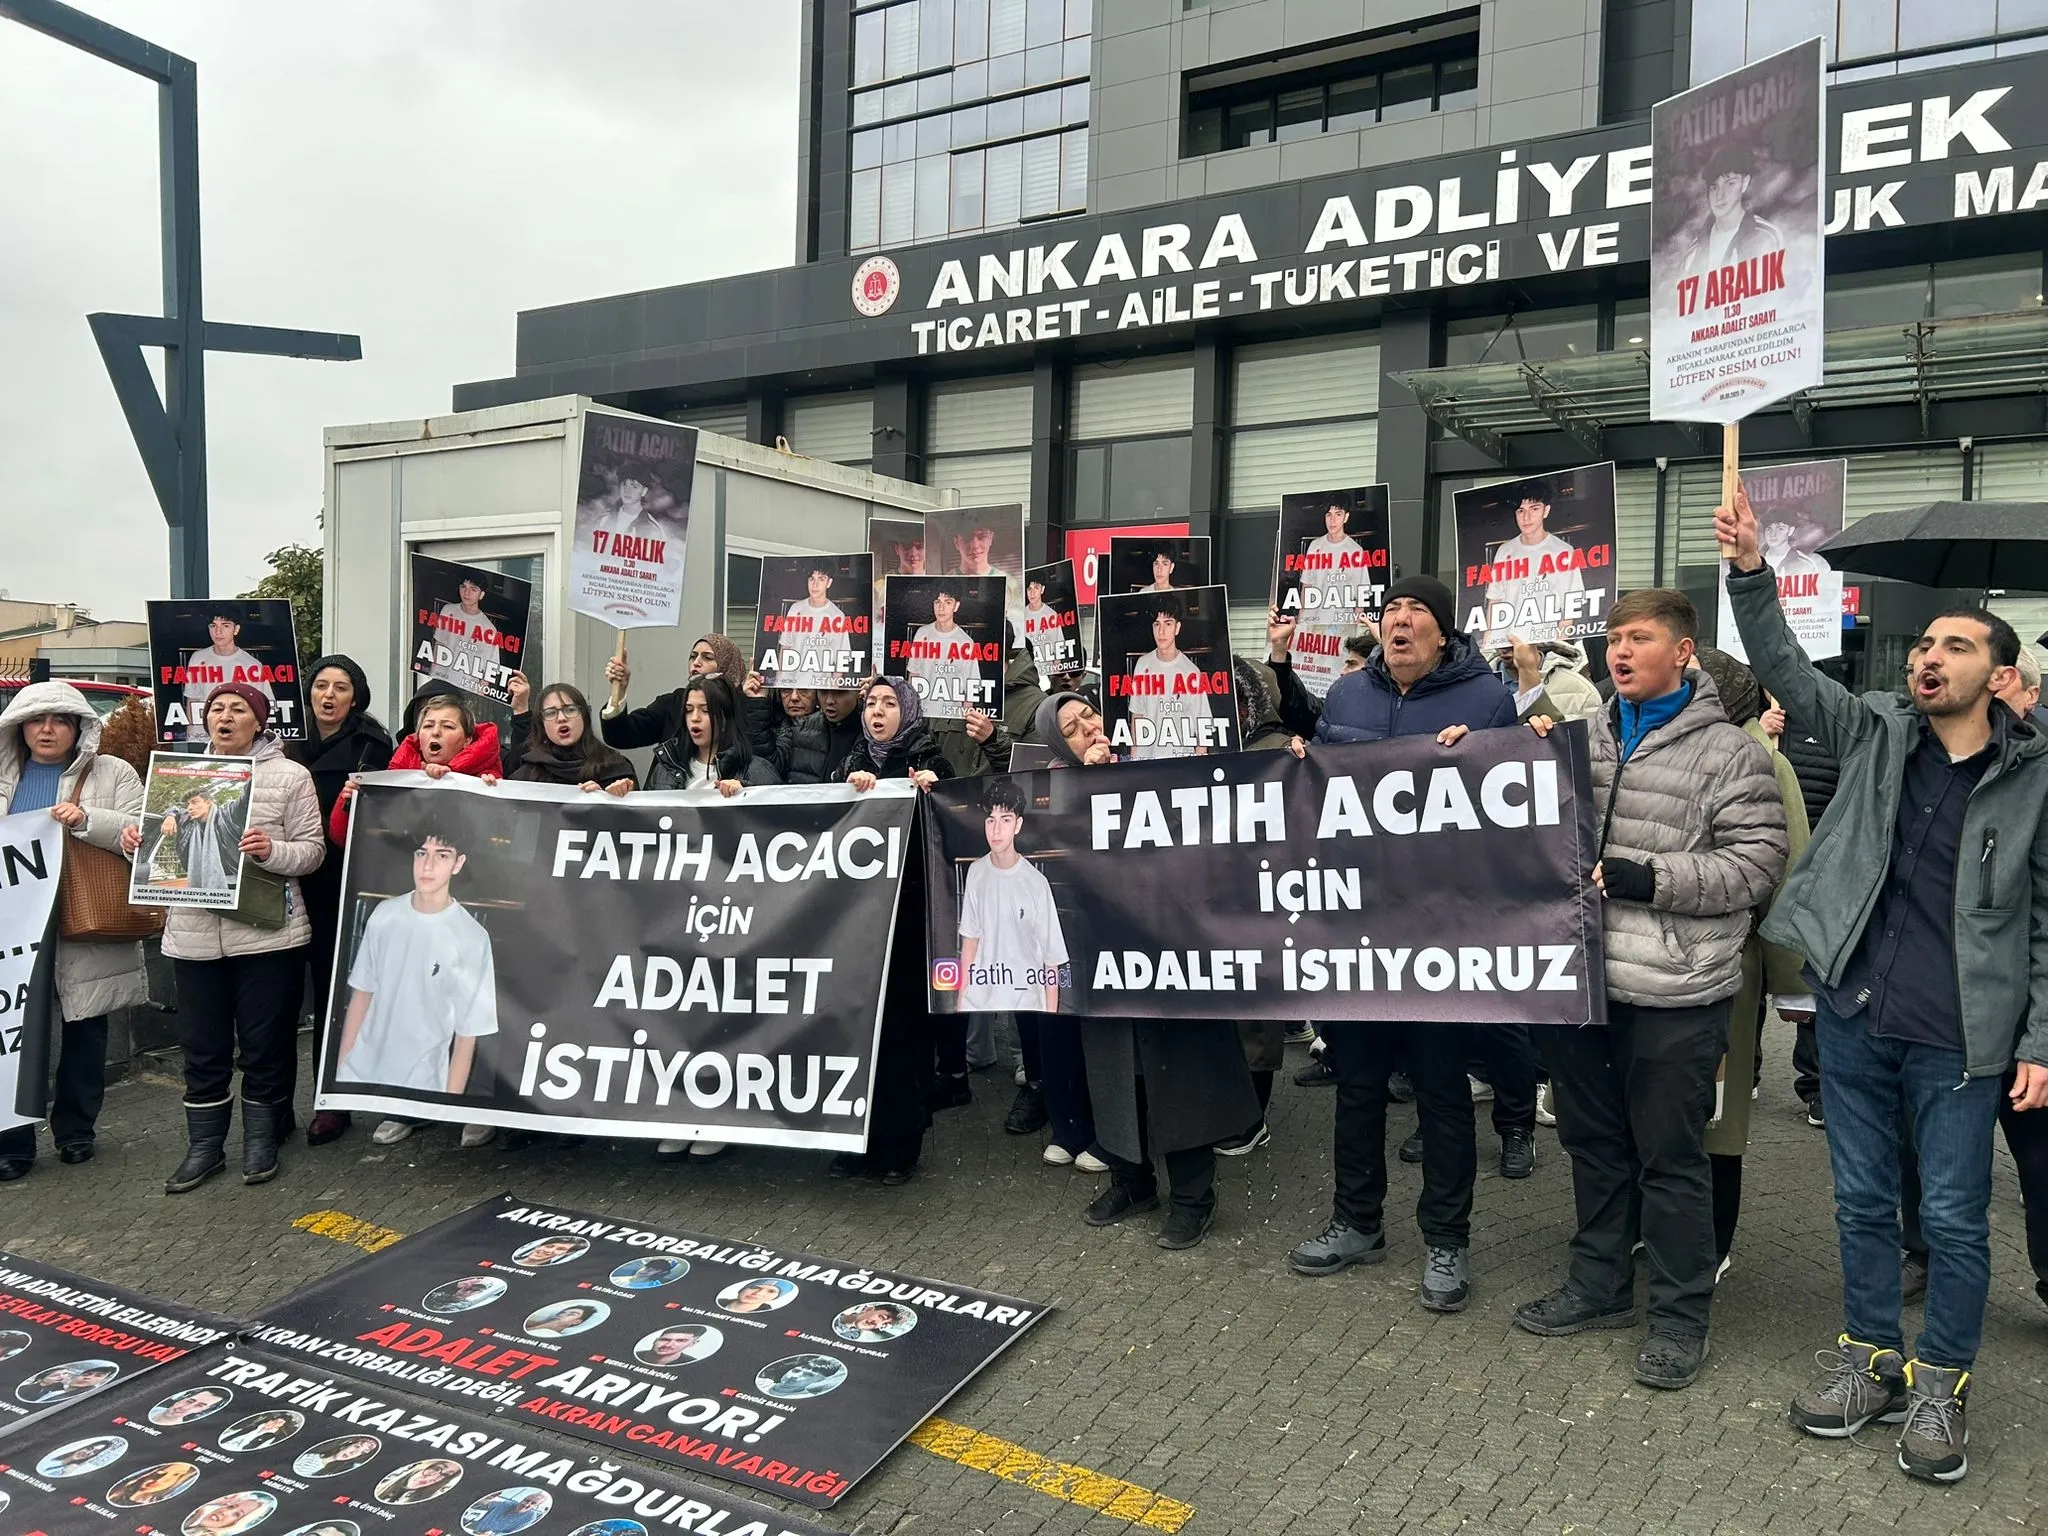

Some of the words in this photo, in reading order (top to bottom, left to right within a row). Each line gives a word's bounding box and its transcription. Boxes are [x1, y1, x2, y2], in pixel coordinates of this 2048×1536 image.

[926, 213, 1259, 309] ANKARA
[1841, 86, 2014, 174] EK
[1537, 222, 1619, 272] VE
[1676, 275, 1700, 317] 17
[1704, 248, 1786, 310] ARALIK
[1690, 325, 1720, 344] ANKARA
[1720, 315, 1748, 335] ADALET
[1748, 308, 1777, 328] SARAYI
[1723, 303, 1742, 319] 11.30
[1666, 349, 1702, 365] AKRANIM
[1703, 336, 1756, 355] TARAFINDAN
[1755, 322, 1808, 343] DEFALARCA
[1676, 350, 1737, 373] BIÇAKLANARAK
[1737, 336, 1795, 357] KATLEDİLDİM
[1669, 366, 1716, 389] LÜTFEN
[1718, 358, 1757, 379] SESİM
[1759, 347, 1803, 366] OLUN!
[591, 528, 610, 554] 17
[611, 532, 668, 565] ARALIK
[1284, 549, 1333, 571] FATİH
[1338, 549, 1388, 569] ACACI
[1465, 555, 1530, 588] FATİH
[1537, 544, 1610, 576] ACACI
[582, 586, 615, 600] LÜTFEN
[616, 591, 644, 604] SESİM
[643, 596, 671, 609] OLUN!
[1282, 584, 1385, 610] ADALET
[1776, 573, 1819, 598] RALIK
[763, 611, 814, 633] FATİH
[818, 615, 869, 634] ACACI
[1039, 610, 1076, 632] ACACI
[1334, 611, 1381, 623] İSTİYORU
[1463, 588, 1606, 634] ADALET
[418, 608, 466, 637] FATİH
[471, 625, 521, 654] ACACI
[890, 636, 941, 659] FATİH
[947, 642, 999, 663] ACACI
[1295, 631, 1343, 657] ARALIK
[1529, 621, 1608, 641] İSTİYORUZ
[416, 640, 513, 688] ADALET
[759, 648, 866, 673] ADALET
[1033, 639, 1076, 662] ALET
[160, 661, 224, 685] FATİH
[231, 664, 295, 684] ACACI
[811, 675, 863, 687] İSTİYORU
[911, 675, 996, 704] DALET
[1109, 668, 1165, 697] FATİH
[1171, 671, 1230, 696] ACACI
[163, 700, 295, 727] ADET
[1110, 717, 1231, 747] ADALET
[1090, 767, 1287, 851] FATİH
[1315, 759, 1561, 840] ACACI
[551, 816, 712, 881] FATİH
[723, 825, 901, 884] ACACI
[1257, 857, 1363, 924] İÇİN
[684, 894, 754, 943] İÇİN
[1091, 949, 1264, 993] ADALET
[1281, 934, 1578, 993] İSTİYORUZ
[592, 954, 834, 1016] ADALET
[517, 1022, 867, 1119] İSTİYORUZ.
[496, 1207, 615, 1241] AKRAN
[611, 1227, 783, 1273] ZORBALIĞI
[775, 1265, 1034, 1329] MAĞDURLARI
[15, 1279, 121, 1317] ADALETİN
[8, 1298, 73, 1327] EVLAT
[56, 1318, 146, 1352] BORCU
[355, 1321, 560, 1381] ADALET
[535, 1365, 788, 1445] ARIYOR!
[205, 1355, 353, 1414] TRAFİK
[332, 1395, 502, 1461] KAZASI
[317, 1342, 456, 1387] ZORBALIĞI
[443, 1376, 526, 1407] DEĞİL
[518, 1396, 632, 1436] AKRAN
[624, 1424, 850, 1498] CANAVARLIĞI
